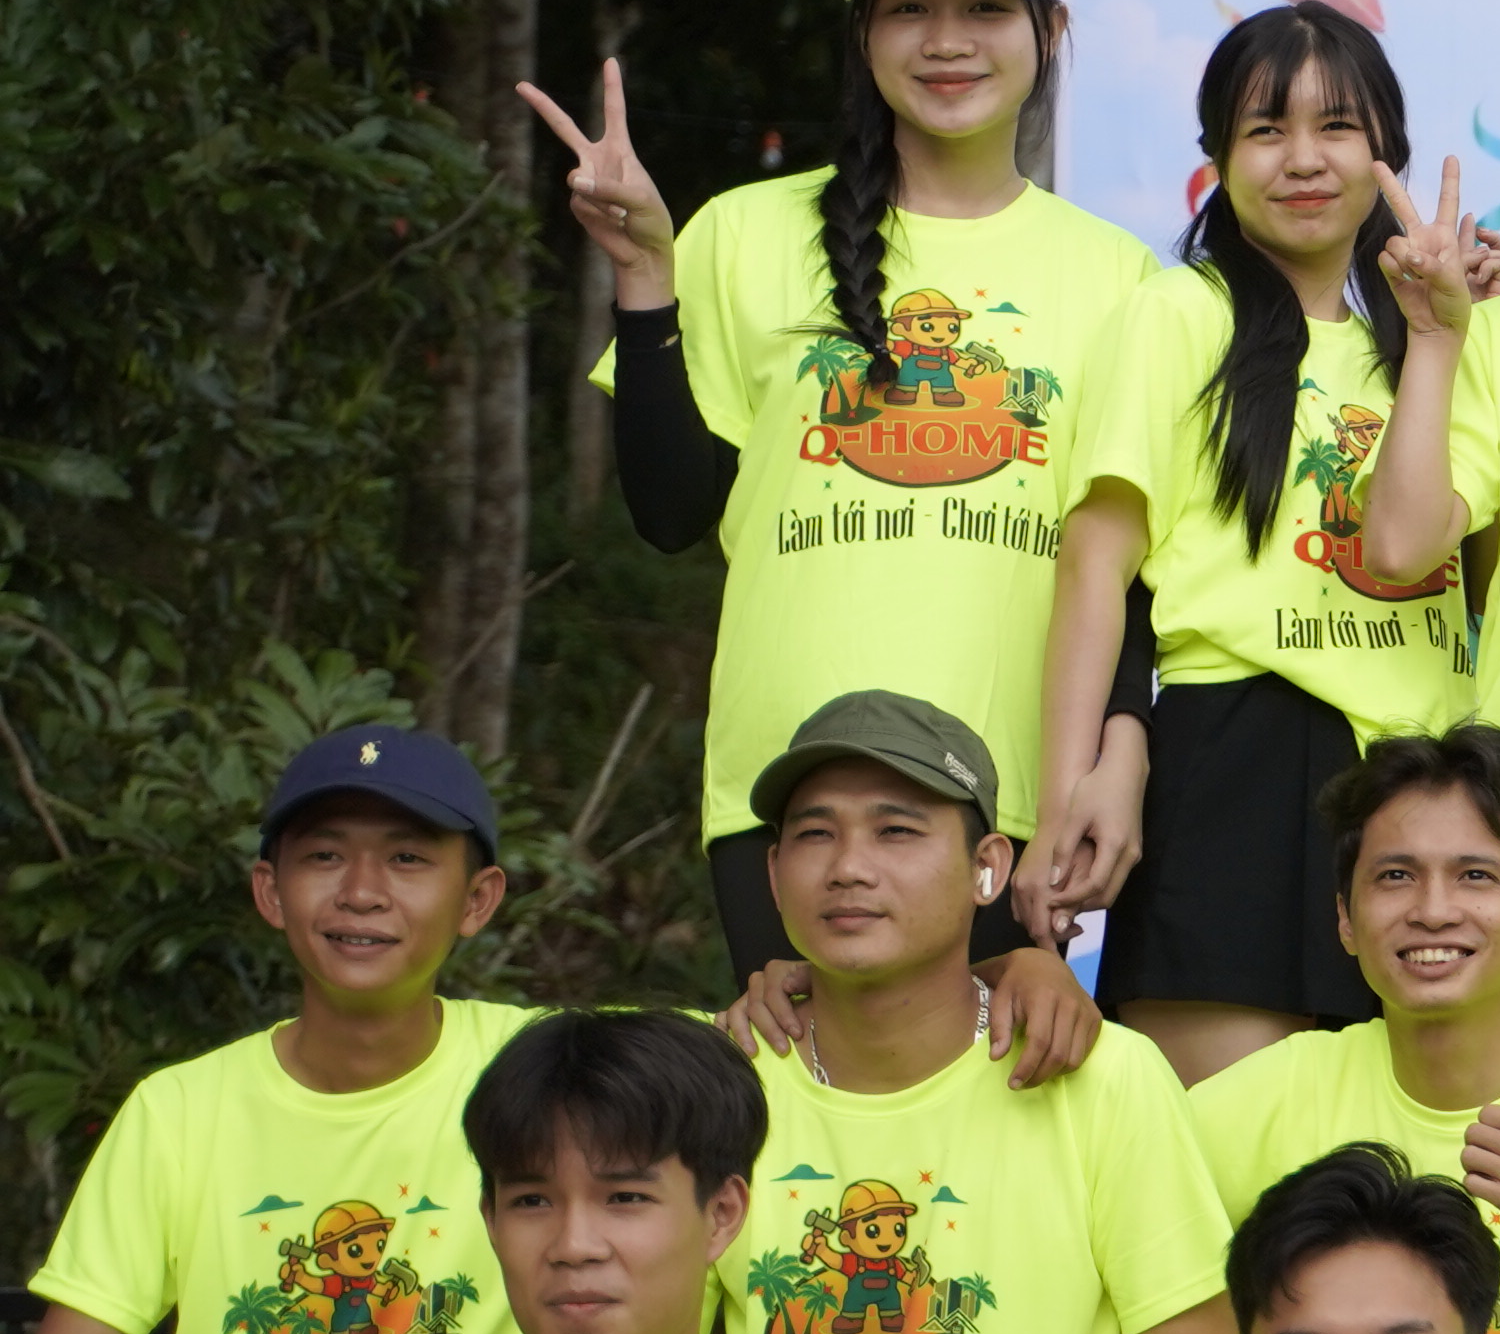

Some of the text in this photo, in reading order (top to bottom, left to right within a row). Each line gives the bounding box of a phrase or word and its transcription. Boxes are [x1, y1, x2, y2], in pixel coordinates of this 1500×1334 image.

[800, 419, 1050, 467] Q-HOME
[778, 509, 823, 555] Làm
[832, 500, 865, 544] tới
[876, 498, 915, 541] nơi
[942, 497, 997, 545] Chơi
[1002, 506, 1031, 553] tới
[1276, 608, 1324, 650] Làm
[1328, 610, 1362, 648] tới
[1364, 610, 1407, 649] nơi
